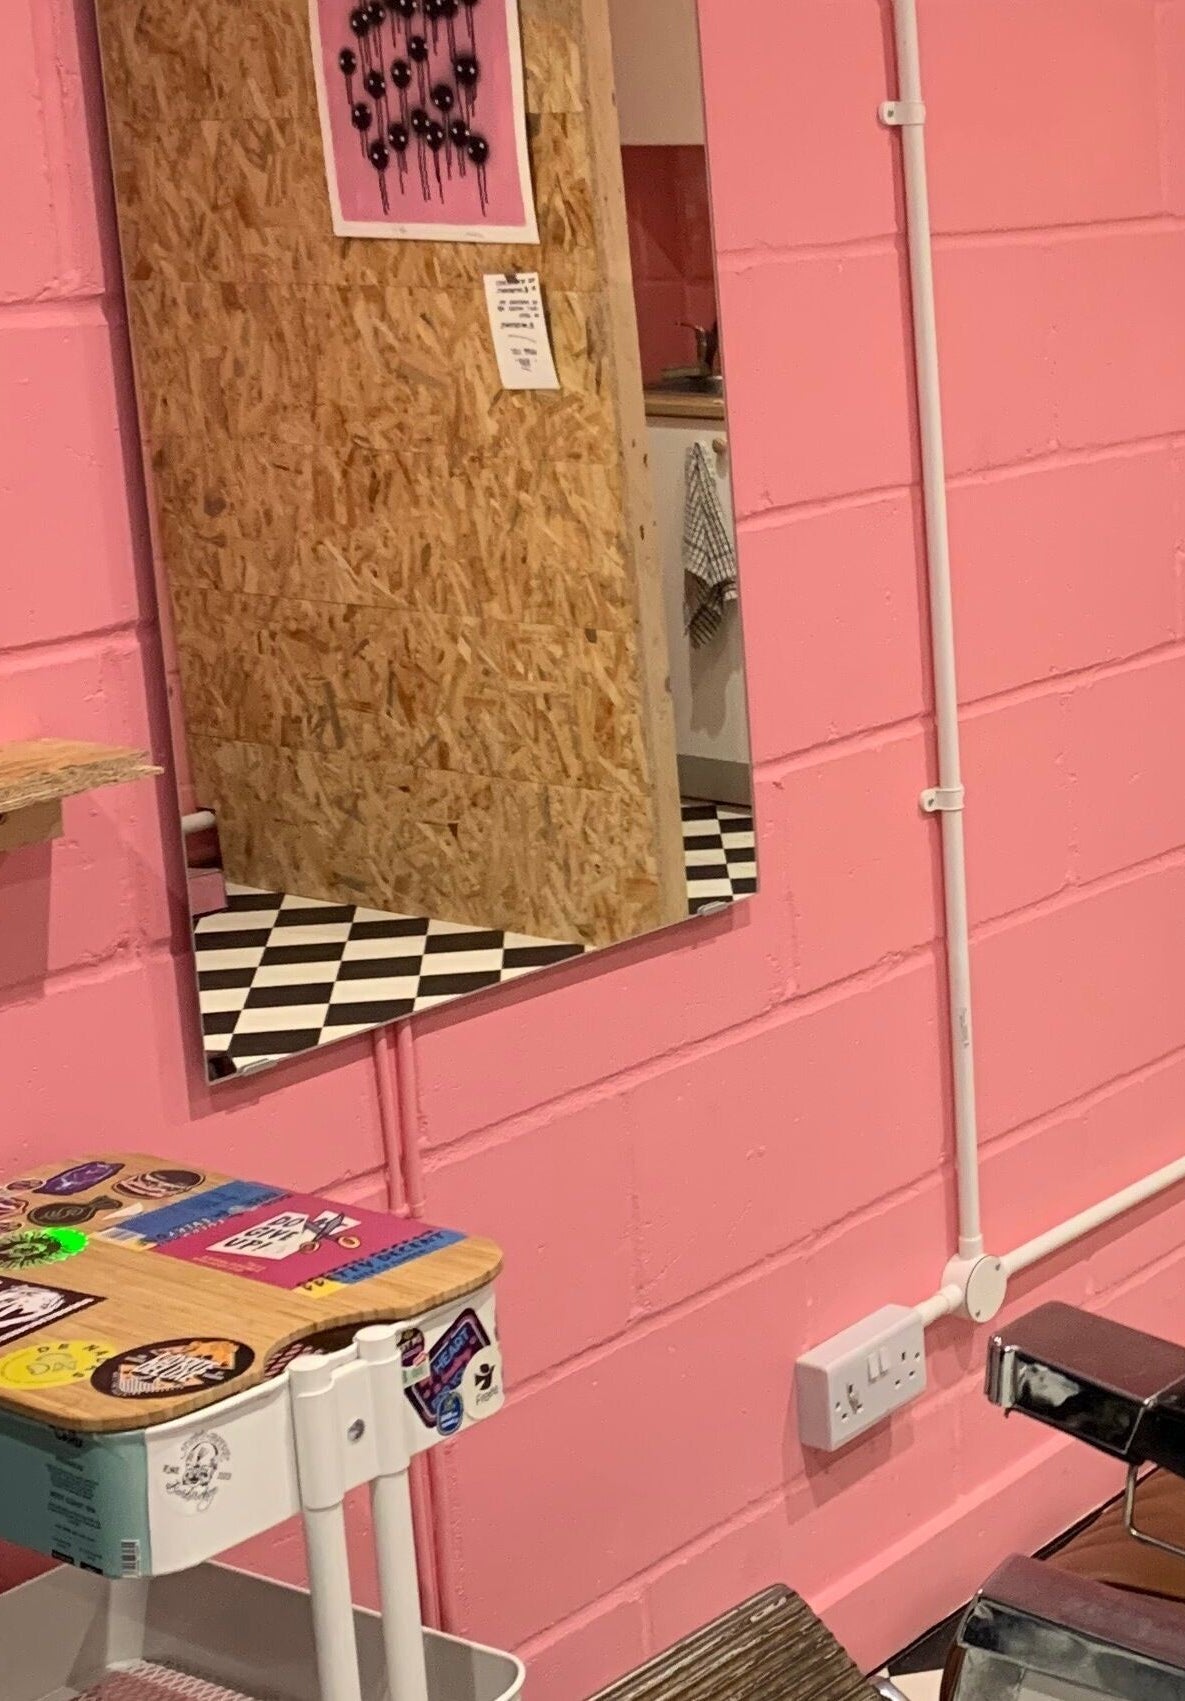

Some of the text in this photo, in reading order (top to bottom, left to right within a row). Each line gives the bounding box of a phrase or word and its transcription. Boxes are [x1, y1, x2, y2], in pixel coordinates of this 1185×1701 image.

[243, 1226, 300, 1242] GIVE
[223, 1237, 273, 1252] UP!
[432, 1326, 470, 1374] HEART
